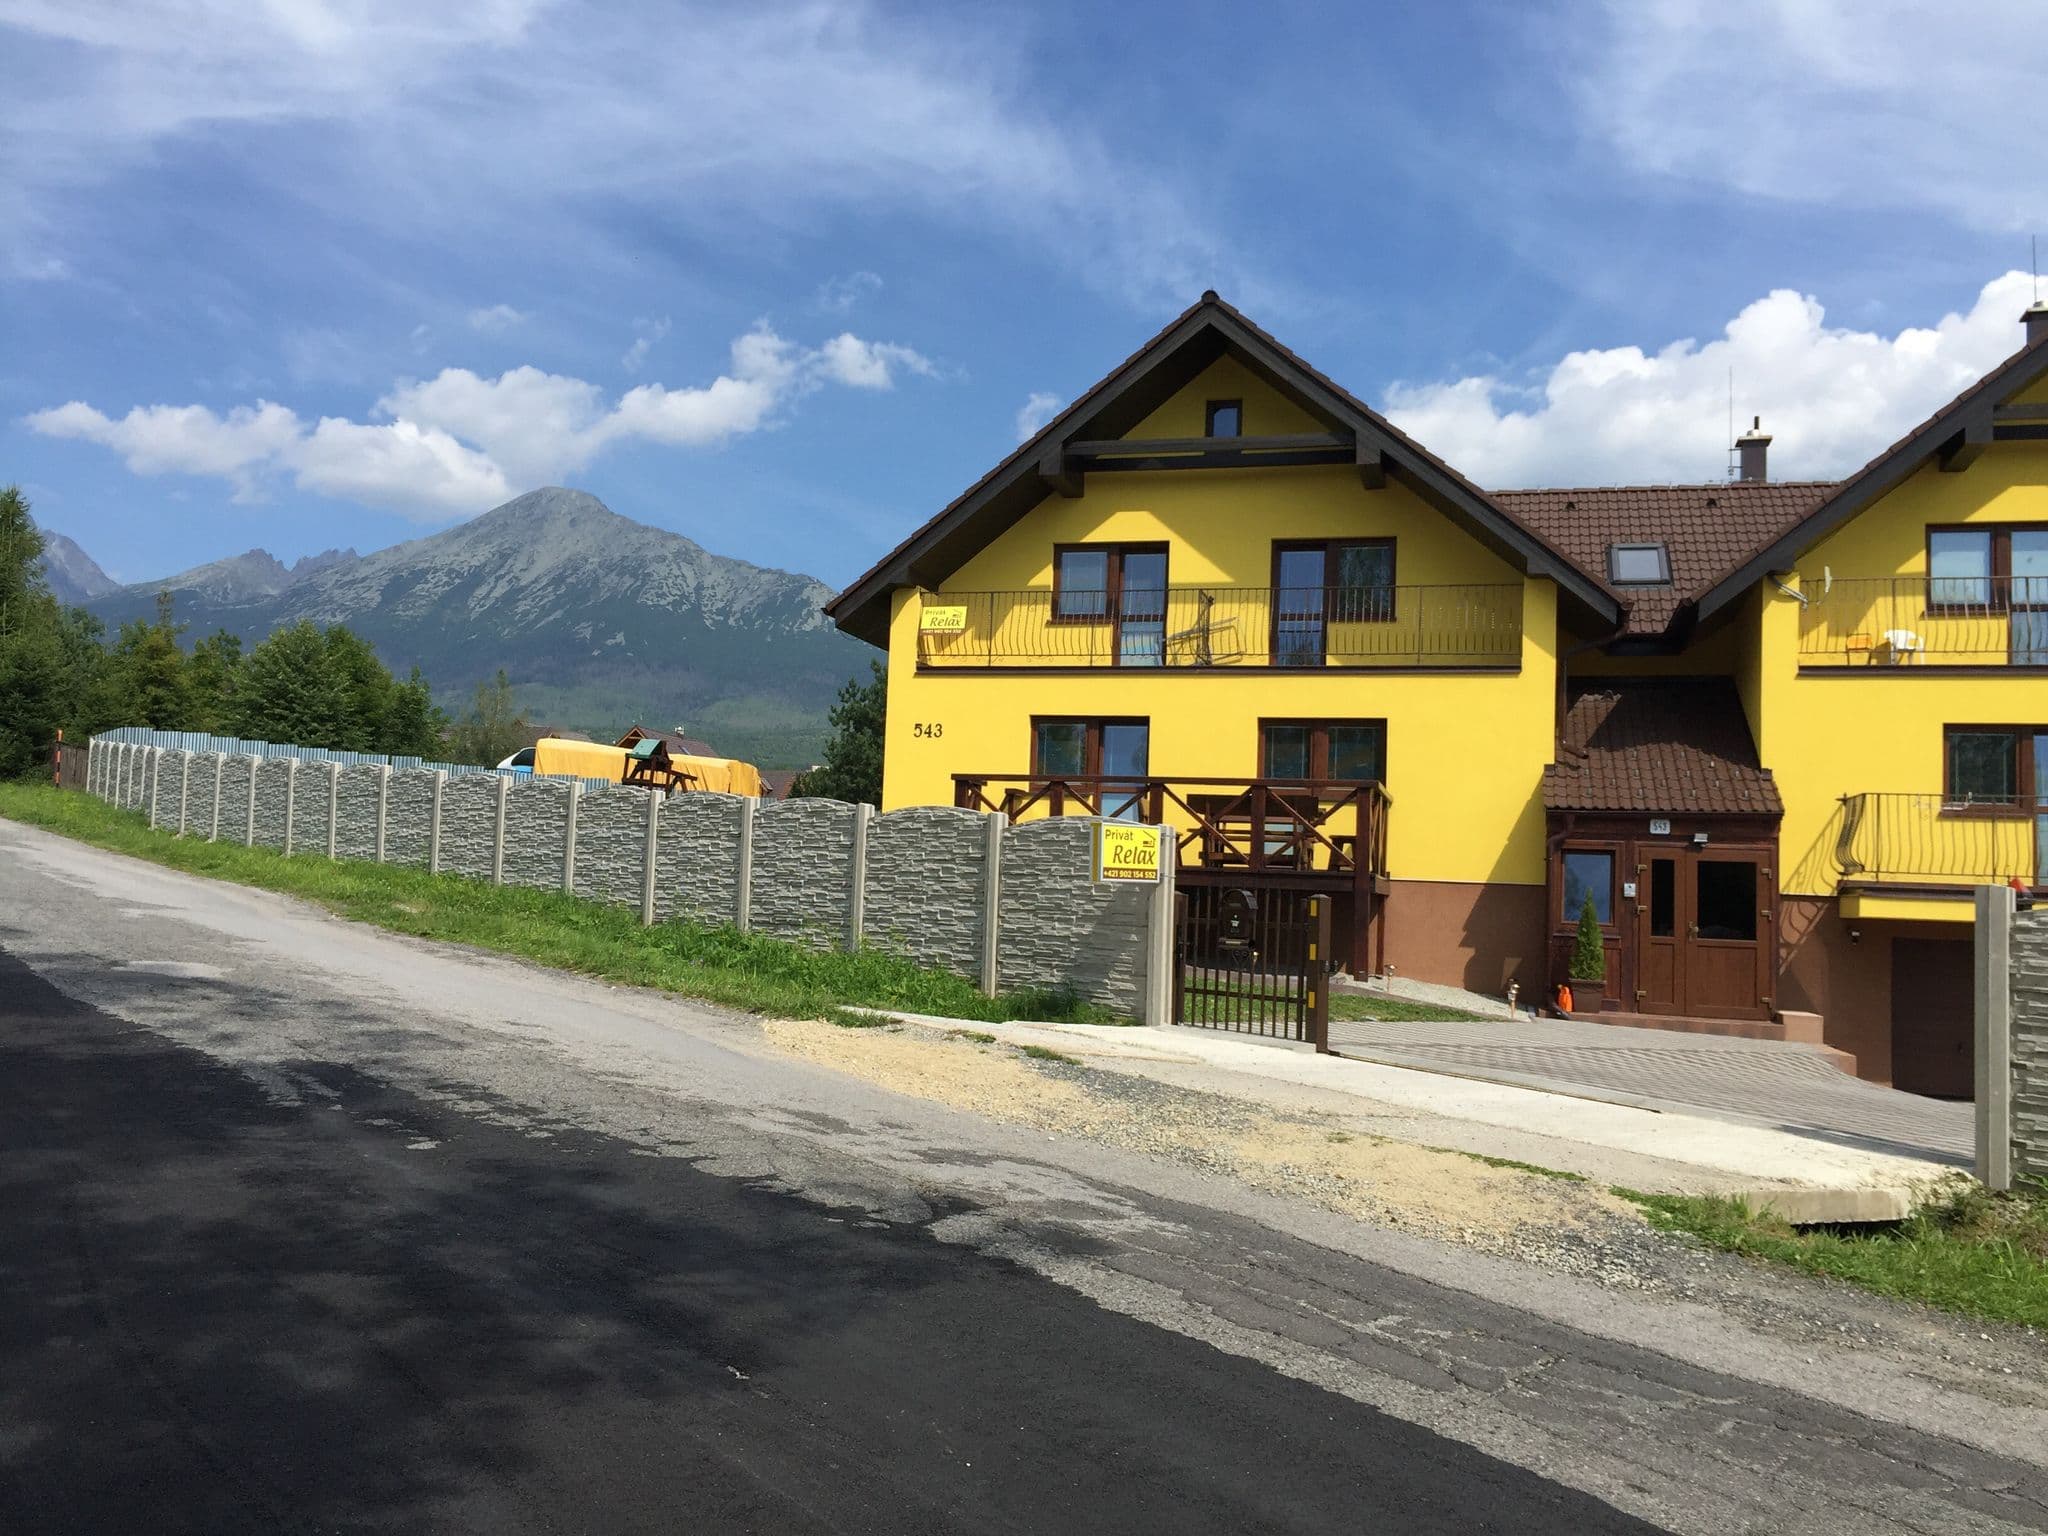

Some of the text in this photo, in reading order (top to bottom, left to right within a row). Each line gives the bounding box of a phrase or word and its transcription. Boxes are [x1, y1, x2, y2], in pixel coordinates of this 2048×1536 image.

[929, 616, 961, 627] Relax
[913, 723, 943, 739] 543
[1105, 829, 1134, 841] Privát
[1112, 844, 1156, 866] Relax
[1103, 869, 1157, 879] +421 902 154 552
